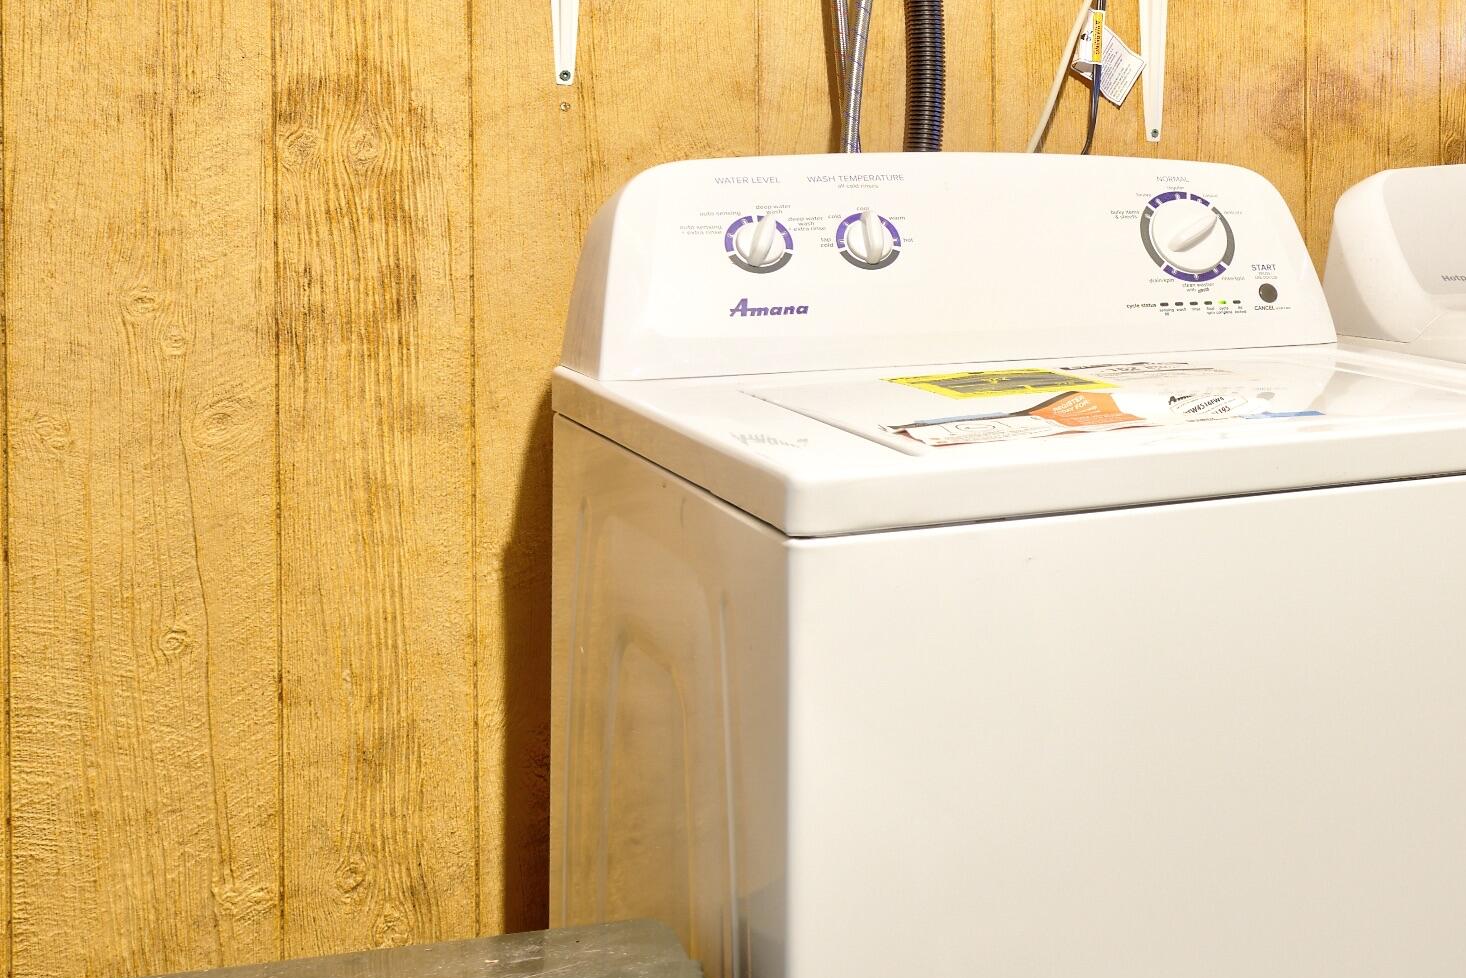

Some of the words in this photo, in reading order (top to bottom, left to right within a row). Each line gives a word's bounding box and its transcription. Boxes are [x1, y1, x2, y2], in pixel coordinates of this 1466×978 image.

[714, 176, 749, 184] WATER
[752, 176, 780, 184] LEVEL
[838, 174, 904, 182] TEMPERATURE
[729, 298, 809, 317] Amana
